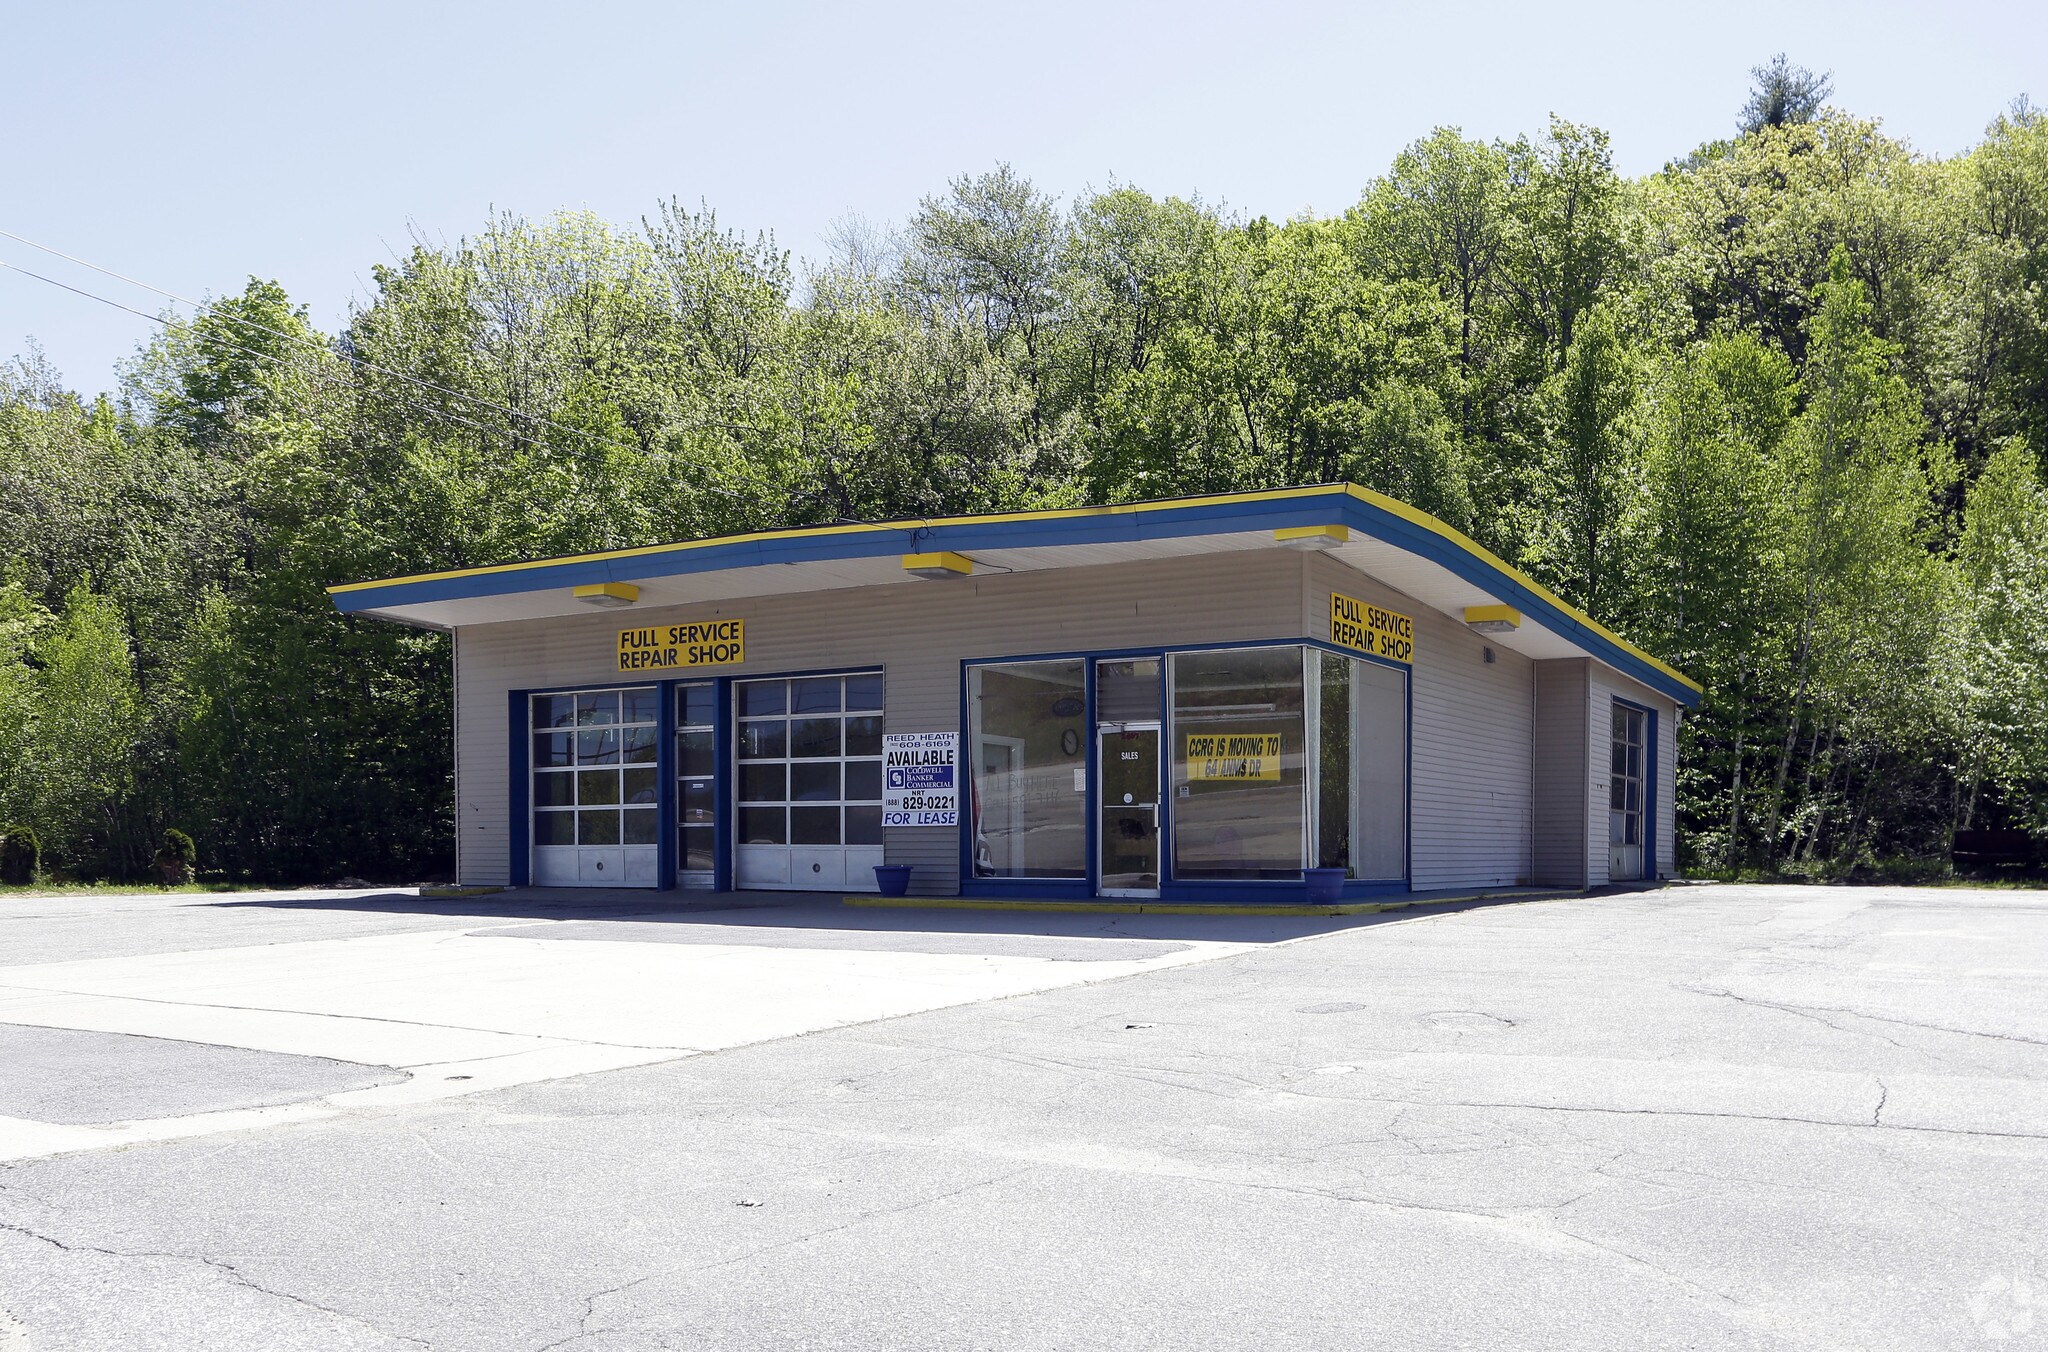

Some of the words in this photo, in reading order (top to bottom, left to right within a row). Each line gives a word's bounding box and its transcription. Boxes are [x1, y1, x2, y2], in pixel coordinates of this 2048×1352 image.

[1334, 596, 1362, 624] FULL
[1367, 607, 1411, 639] SERVICE
[621, 629, 659, 649] FULL
[668, 622, 740, 645] SERVICE
[1333, 620, 1375, 652] REPAIR
[1380, 635, 1412, 661] SHOP
[620, 648, 678, 669] REPAIR
[688, 643, 741, 664] SHOP
[886, 734, 916, 742] REED
[920, 733, 955, 741] HEATH
[1189, 737, 1214, 757] CCRG
[1216, 737, 1226, 757] IS
[1228, 737, 1264, 757] MOVING
[1266, 737, 1279, 757] TO
[887, 750, 954, 766] AVAILABLE
[1121, 751, 1139, 760] SALES
[1205, 758, 1218, 777] 64
[1249, 759, 1262, 777] DR
[906, 781, 953, 789] COMMERCIAL
[884, 812, 911, 824] FOR
[917, 812, 956, 824] LEASE
